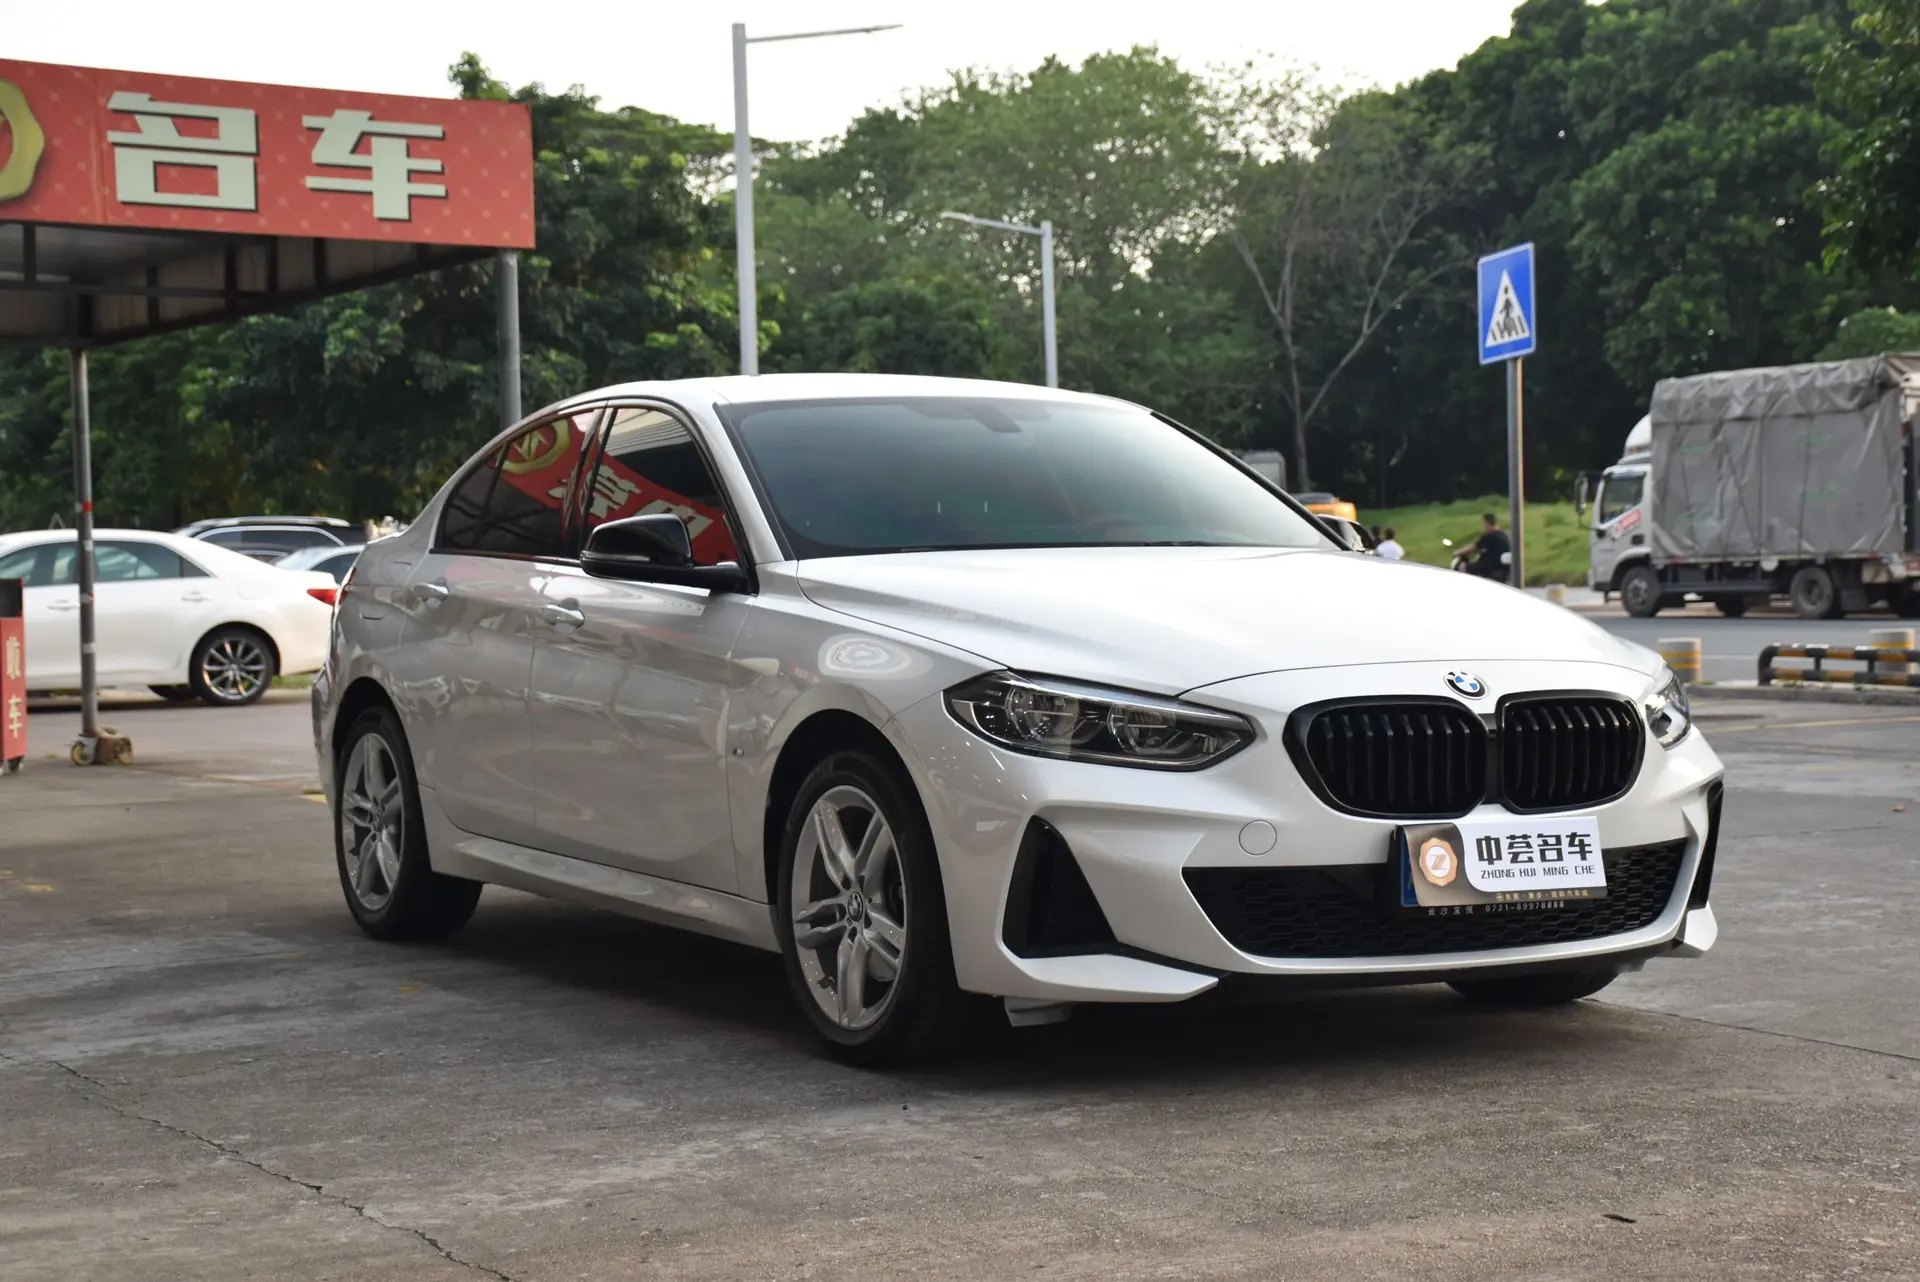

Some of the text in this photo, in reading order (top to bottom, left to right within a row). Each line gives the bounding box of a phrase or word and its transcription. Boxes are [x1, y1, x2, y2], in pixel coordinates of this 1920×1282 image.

[107, 91, 447, 221] 名车
[1476, 832, 1593, 865] 中荟名车
[1480, 865, 1595, 879] ZHONG HUI MING CHE
